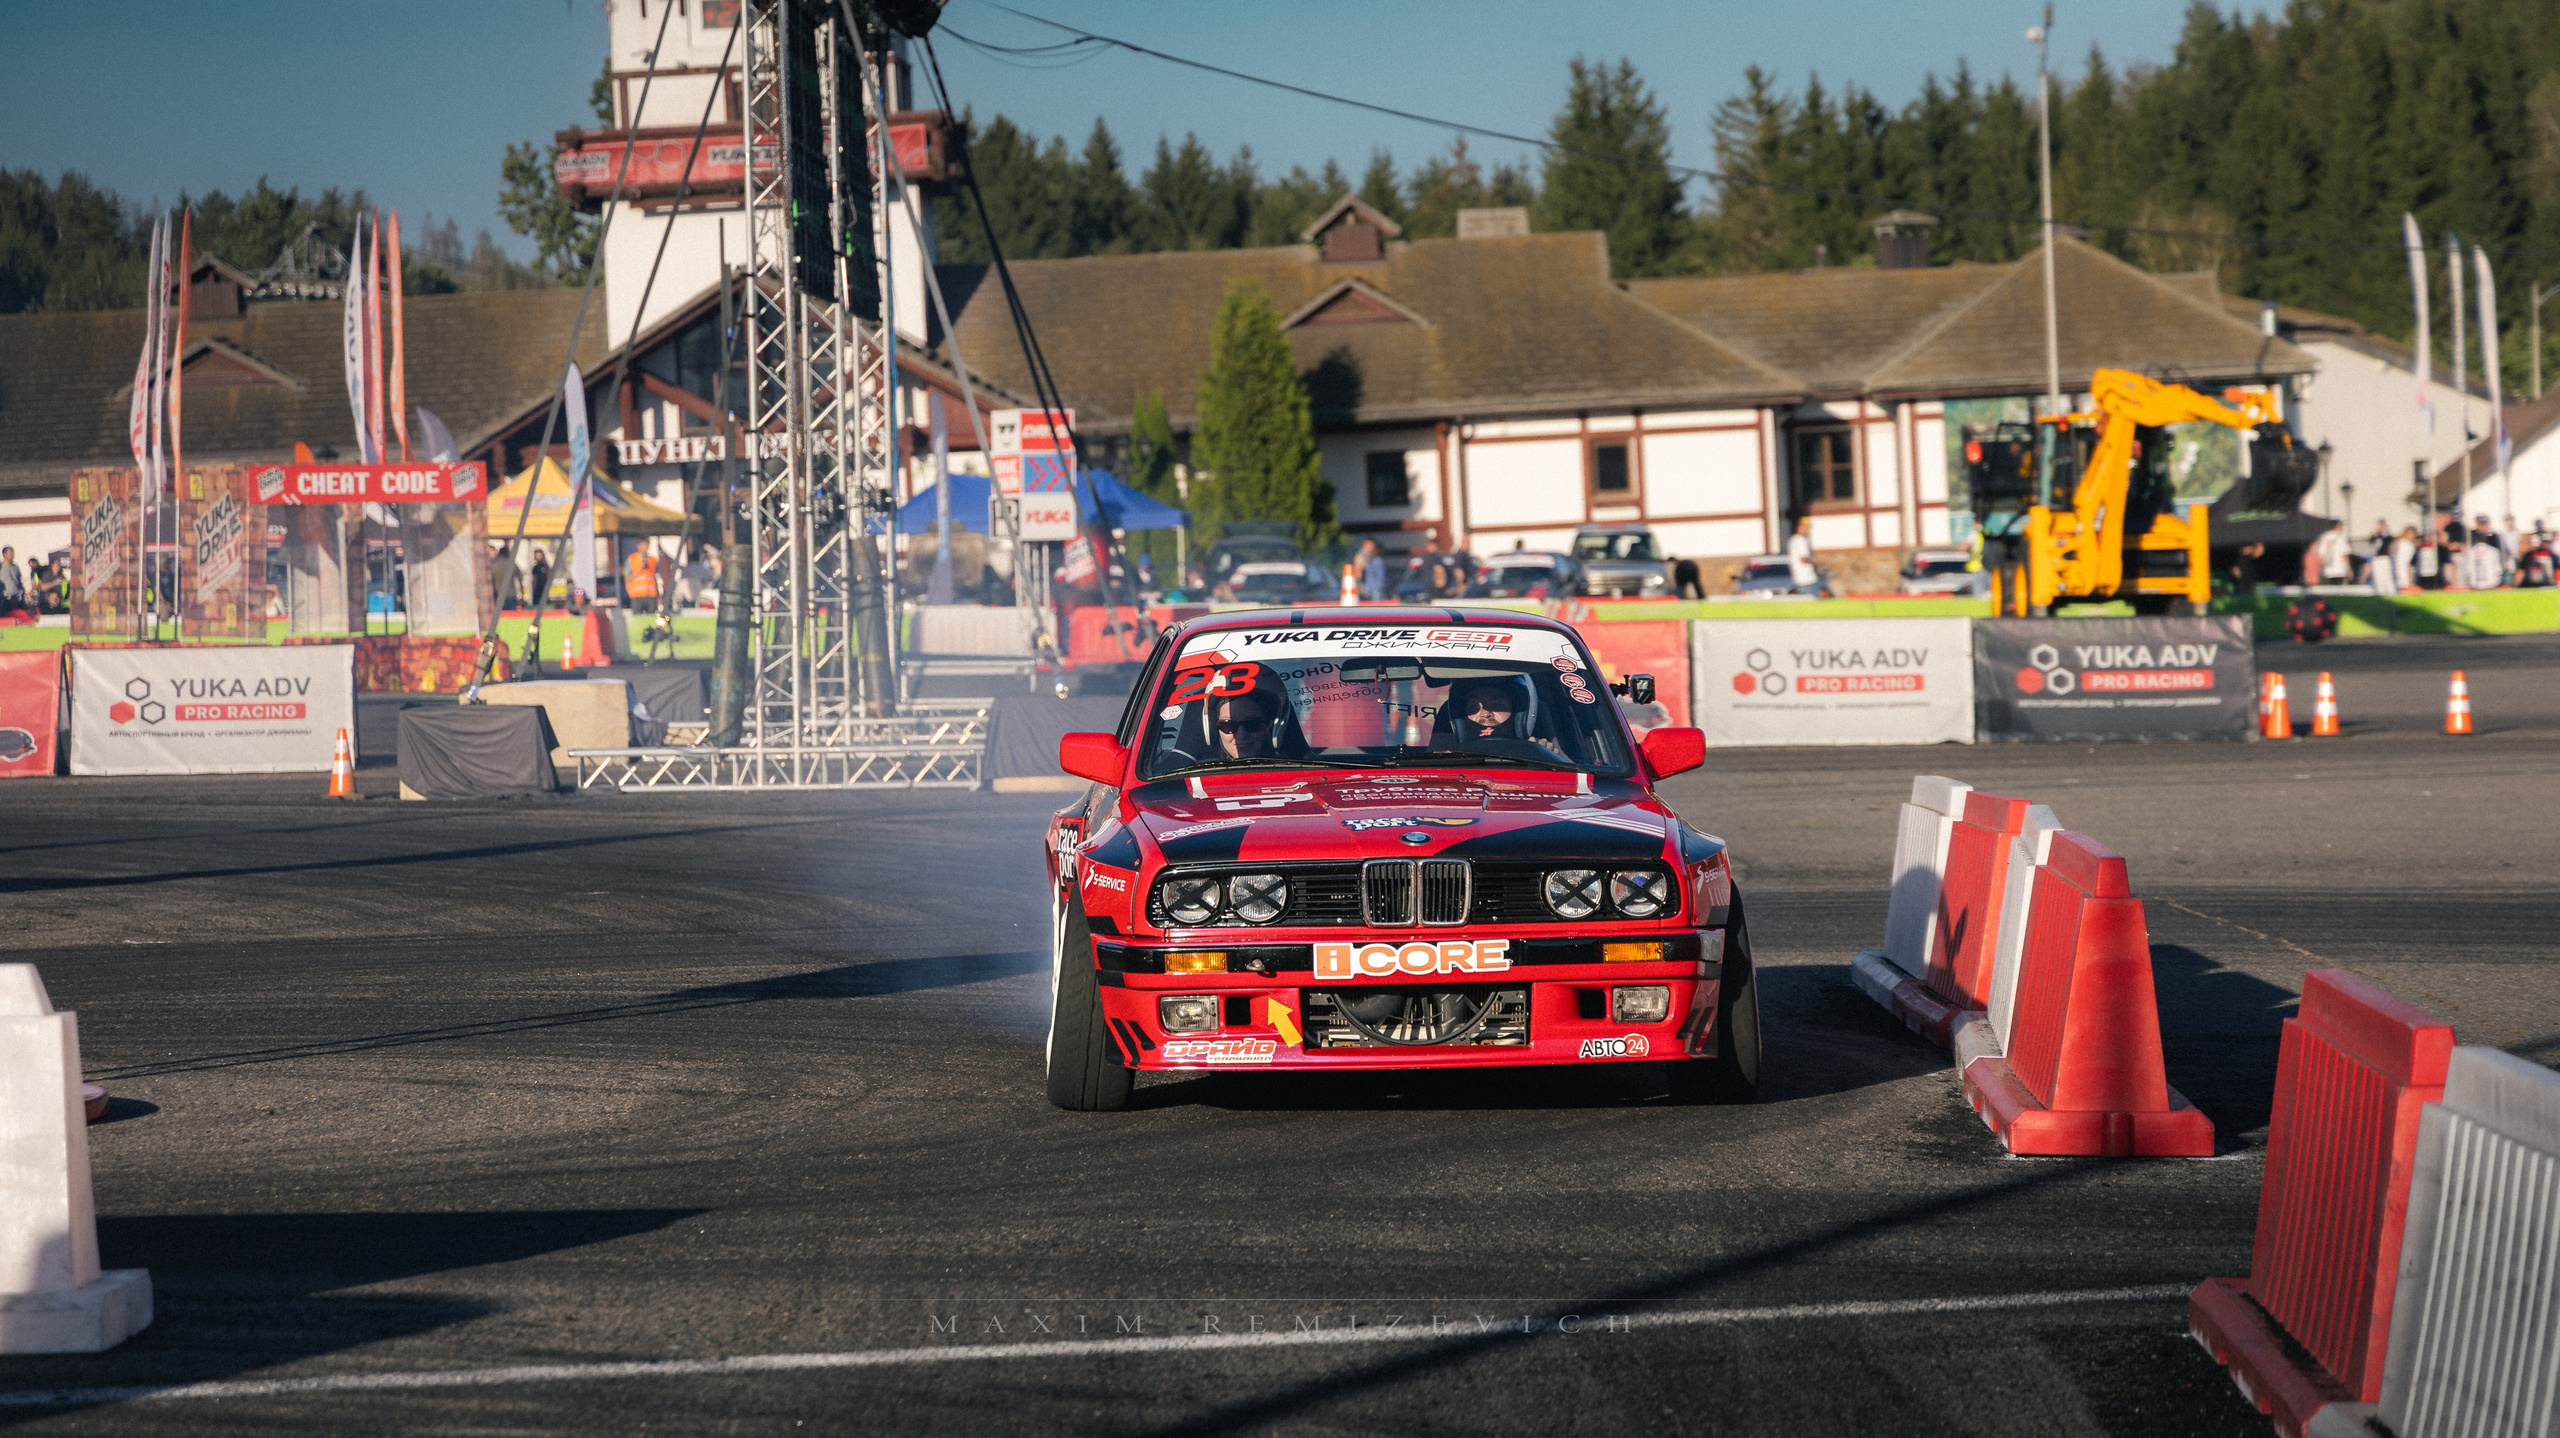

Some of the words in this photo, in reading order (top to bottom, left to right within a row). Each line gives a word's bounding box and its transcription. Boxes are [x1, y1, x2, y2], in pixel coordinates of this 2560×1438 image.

[298, 472, 370, 495] CHEAT
[381, 471, 440, 494] CODE
[196, 494, 233, 536] YUKA
[1244, 631, 1319, 646] YUKA
[1324, 630, 1420, 641] DRIVE
[1432, 631, 1510, 643] FEST
[1341, 641, 1511, 652] ДЖИМХАНА
[1791, 650, 1866, 669] YUKA
[1873, 649, 1929, 667] ADV
[2075, 645, 2155, 668] YUKA
[2160, 644, 2218, 667] ADV
[170, 677, 247, 698] YUKA
[254, 676, 311, 697] ADV
[1167, 662, 1260, 706] 23
[1805, 678, 1842, 691] PRO
[1847, 676, 1916, 690] RACING
[2092, 675, 2130, 688] PRO
[2134, 673, 2205, 687] RACING
[184, 706, 222, 719] PRO
[227, 704, 297, 718] RACING
[1058, 828, 1078, 855] race
[1093, 873, 1127, 892] S-SERVICE
[1166, 1038, 1275, 1056] ДРАЙВ
